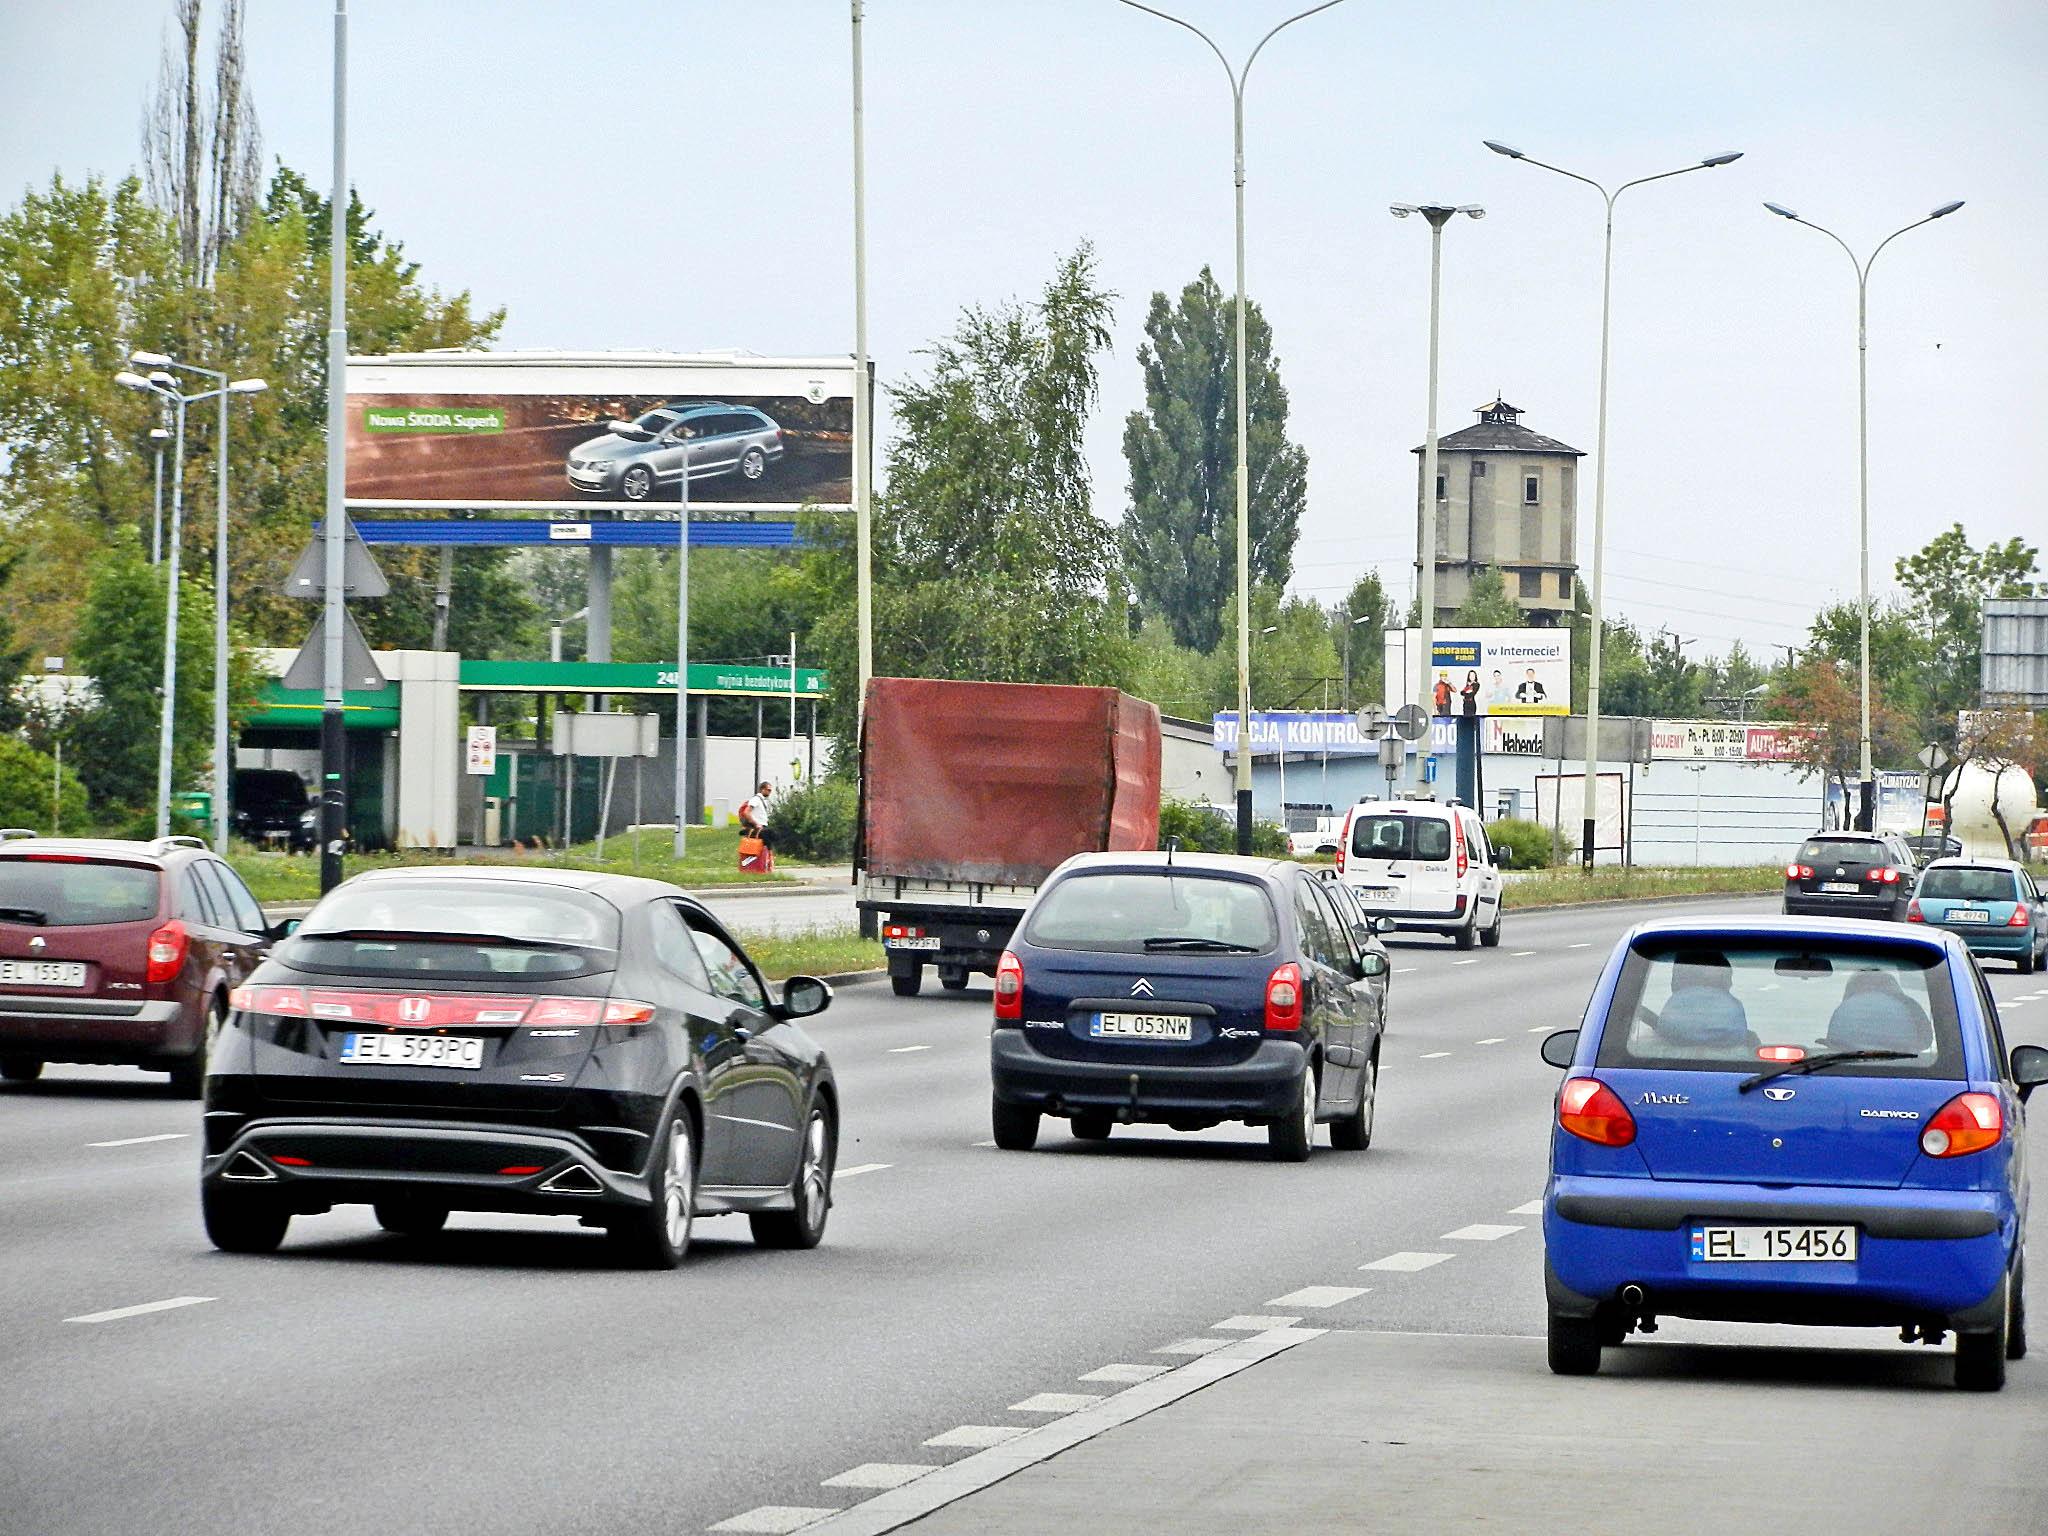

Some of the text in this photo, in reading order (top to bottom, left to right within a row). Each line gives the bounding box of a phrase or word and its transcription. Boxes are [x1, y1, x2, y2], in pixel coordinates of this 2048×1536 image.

[369, 414, 406, 427] Nowa
[454, 414, 499, 430] Superb
[1432, 647, 1476, 655] anorama
[1487, 645, 1560, 656] w Internecie!
[744, 674, 792, 691] bezdotykow
[1287, 721, 1365, 744] KONTRO
[1648, 734, 1685, 749] ACUJEMY
[1750, 735, 1776, 753] AUTO
[2, 963, 23, 980] EL
[1103, 1014, 1188, 1035] EL 053NW
[357, 1036, 478, 1063] EL 593PC
[1634, 1091, 1690, 1105] Matiz
[1859, 1109, 1920, 1119] DAEWOO
[1708, 1230, 1848, 1258] EL 15456
